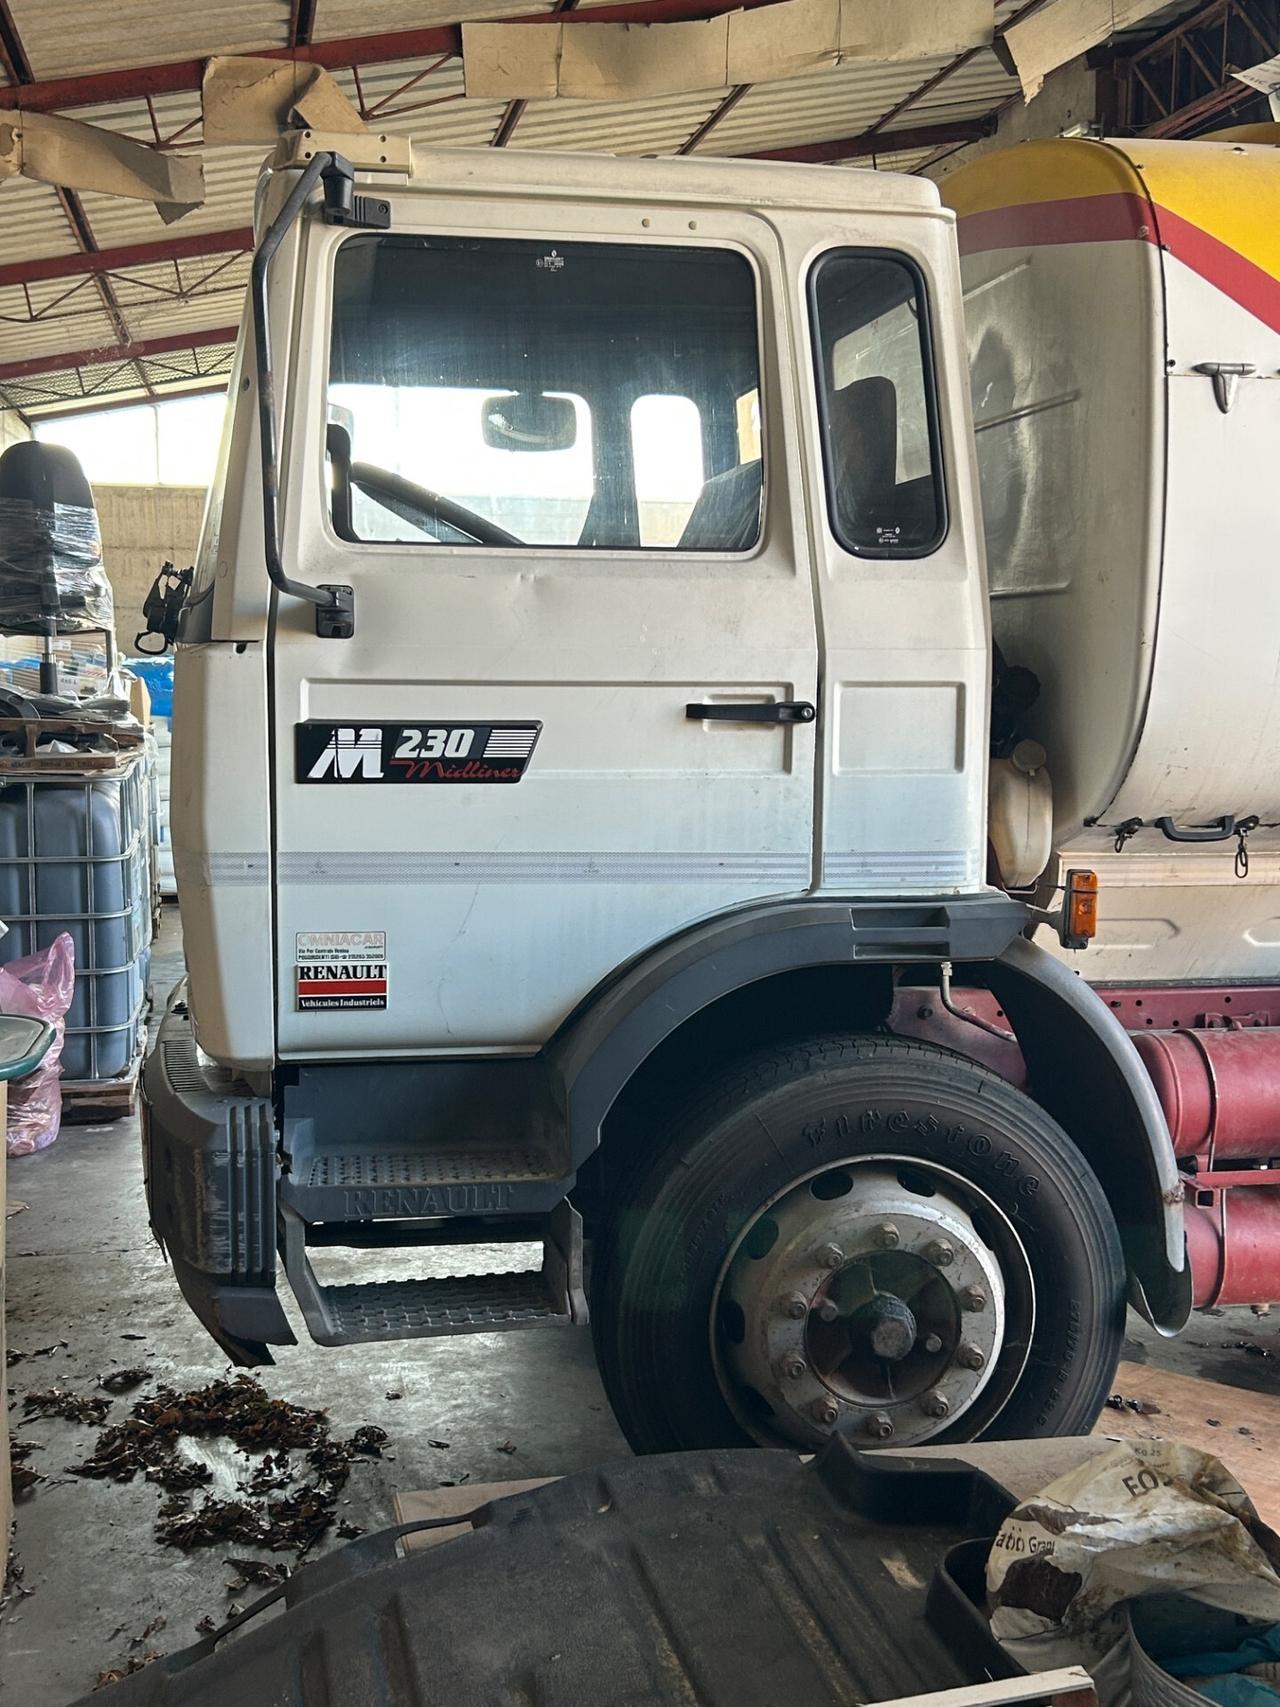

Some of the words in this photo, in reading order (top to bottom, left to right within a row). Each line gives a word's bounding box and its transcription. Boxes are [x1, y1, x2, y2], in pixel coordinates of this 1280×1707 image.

[394, 729, 471, 758] 230
[389, 759, 524, 779] Midliner
[299, 966, 387, 979] RENAULT
[340, 998, 384, 1007] Industriels
[802, 1108, 1041, 1198] Firestone
[344, 1184, 514, 1217] RENAULT
[1134, 1447, 1147, 1456] Kg
[1150, 1449, 1162, 1457] 25
